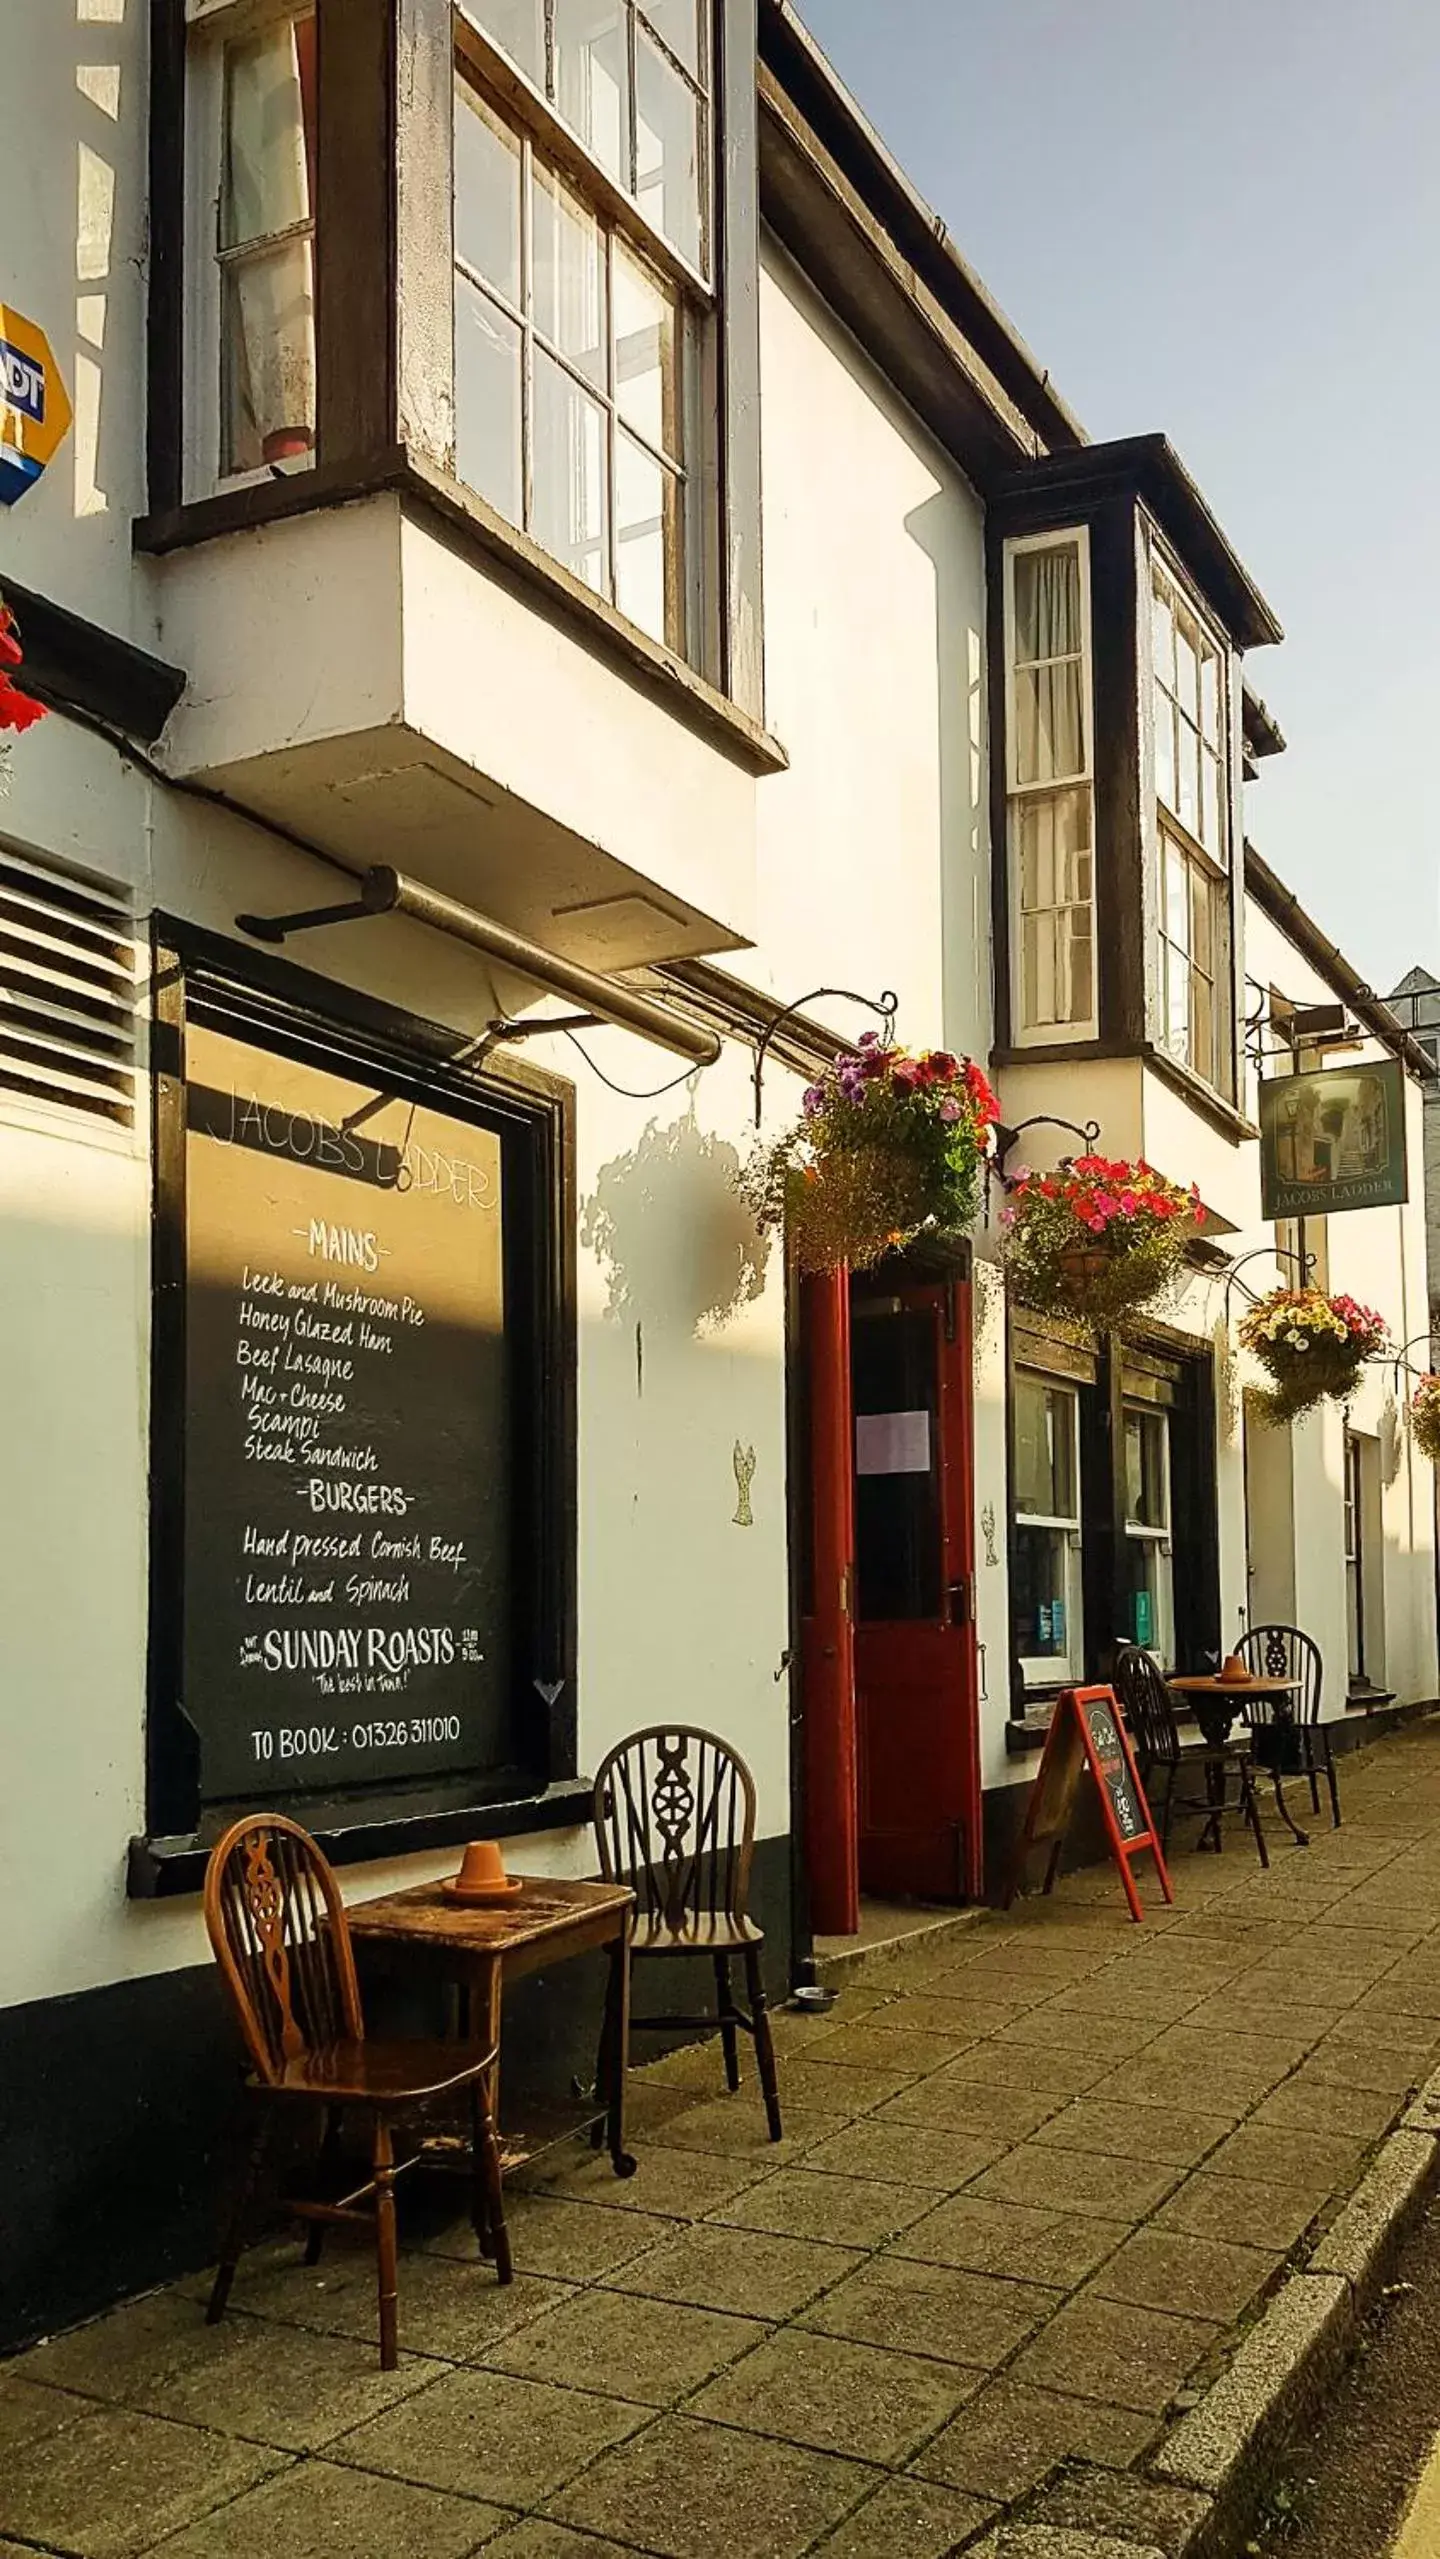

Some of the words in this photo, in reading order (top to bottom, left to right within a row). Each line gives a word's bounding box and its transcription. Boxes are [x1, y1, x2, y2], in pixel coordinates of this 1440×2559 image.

[206, 1081, 365, 1172] JACOBS
[1274, 1188, 1327, 1211] JACOBS
[1331, 1180, 1393, 1201] LADDER
[242, 1265, 285, 1298] Leek
[287, 1282, 318, 1303] and
[323, 1281, 400, 1321] Mushroom
[401, 1295, 426, 1327] Pie
[238, 1301, 291, 1341] Honey
[294, 1308, 354, 1346] Glazed
[358, 1323, 394, 1354] Ham
[236, 1340, 281, 1376] Beef
[284, 1343, 355, 1389] Lasagne
[240, 1374, 277, 1406] Mac
[290, 1382, 347, 1413] Cheese
[247, 1403, 321, 1441] Scampi
[244, 1434, 297, 1464] Steak
[299, 1439, 381, 1471] Sandwich
[370, 1530, 421, 1560] Cornish
[428, 1536, 468, 1575] Beef
[244, 1573, 305, 1604] Lentil
[306, 1580, 335, 1603] and
[345, 1573, 410, 1607] Spinach
[263, 1628, 363, 1672] SUNDAY
[367, 1626, 455, 1673] ROASTS
[252, 1730, 273, 1761] TO
